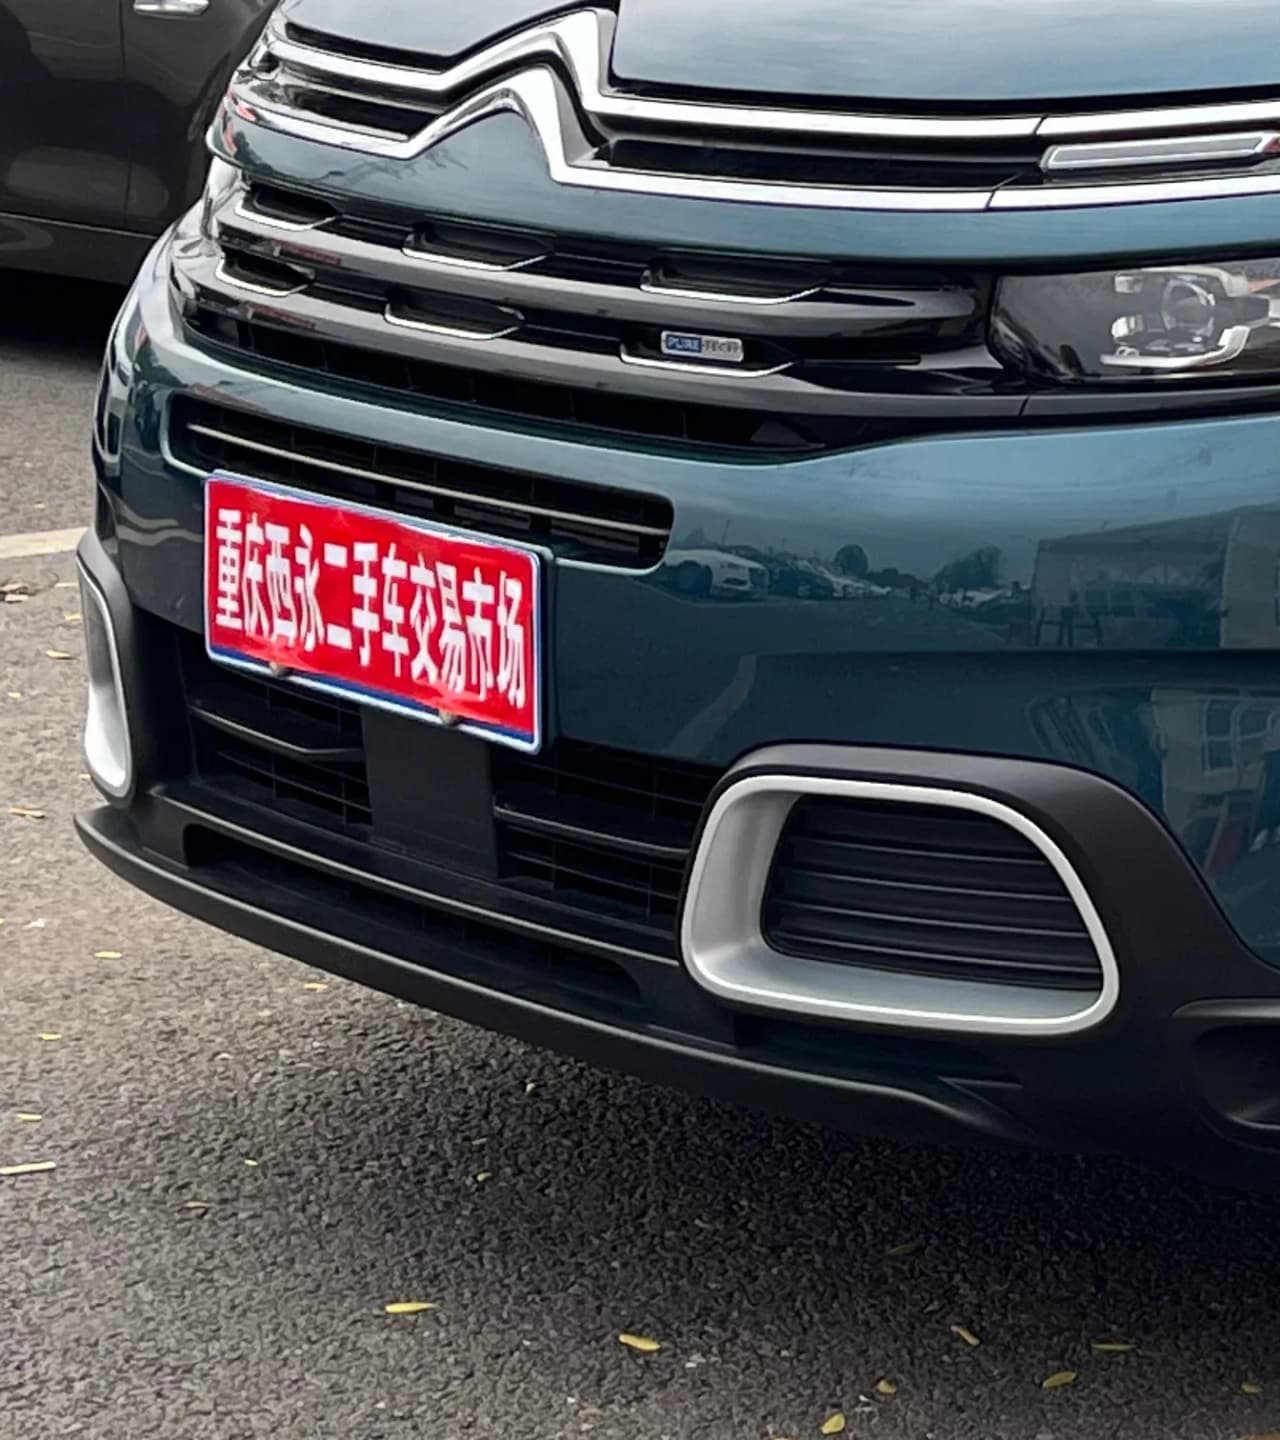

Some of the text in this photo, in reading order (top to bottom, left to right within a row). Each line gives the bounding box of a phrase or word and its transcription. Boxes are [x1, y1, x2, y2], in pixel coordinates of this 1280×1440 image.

[215, 508, 527, 709] 重庆西永二手车交易市场
